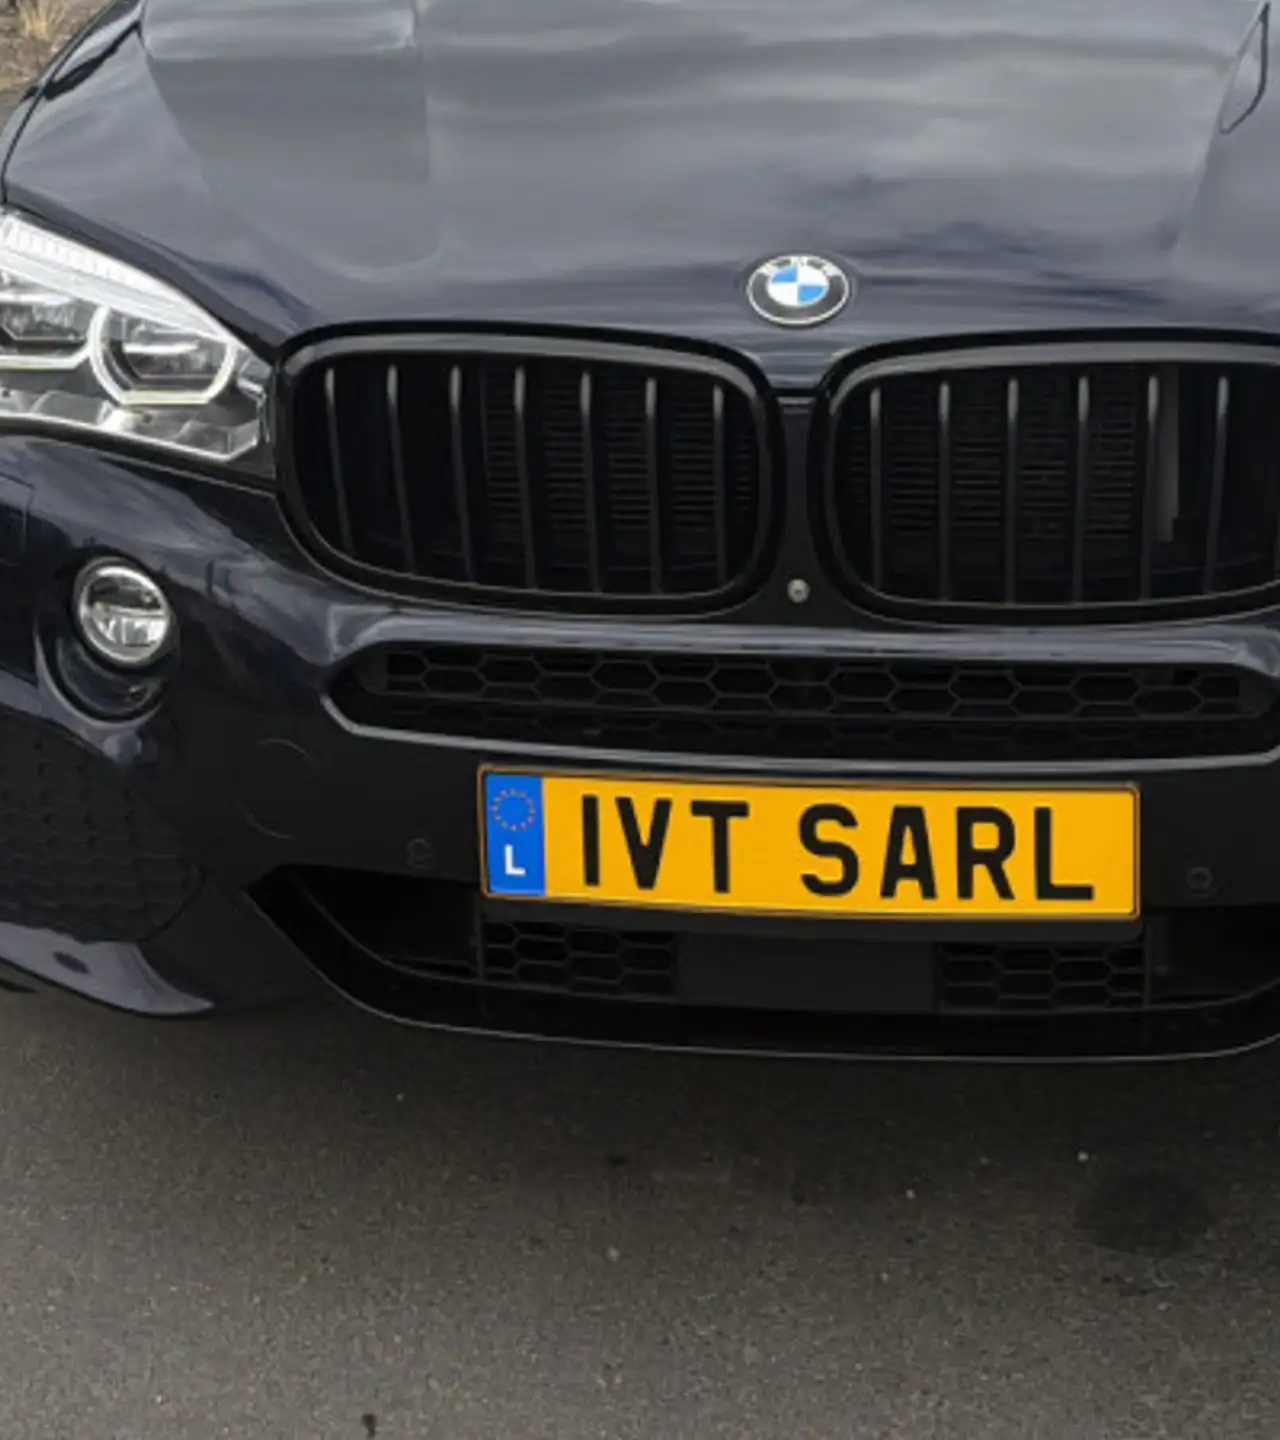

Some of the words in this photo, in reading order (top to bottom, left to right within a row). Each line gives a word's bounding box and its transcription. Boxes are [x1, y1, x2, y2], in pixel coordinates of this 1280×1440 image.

[505, 844, 526, 876] L
[581, 794, 750, 894] IVT
[798, 803, 1095, 901] SARL
